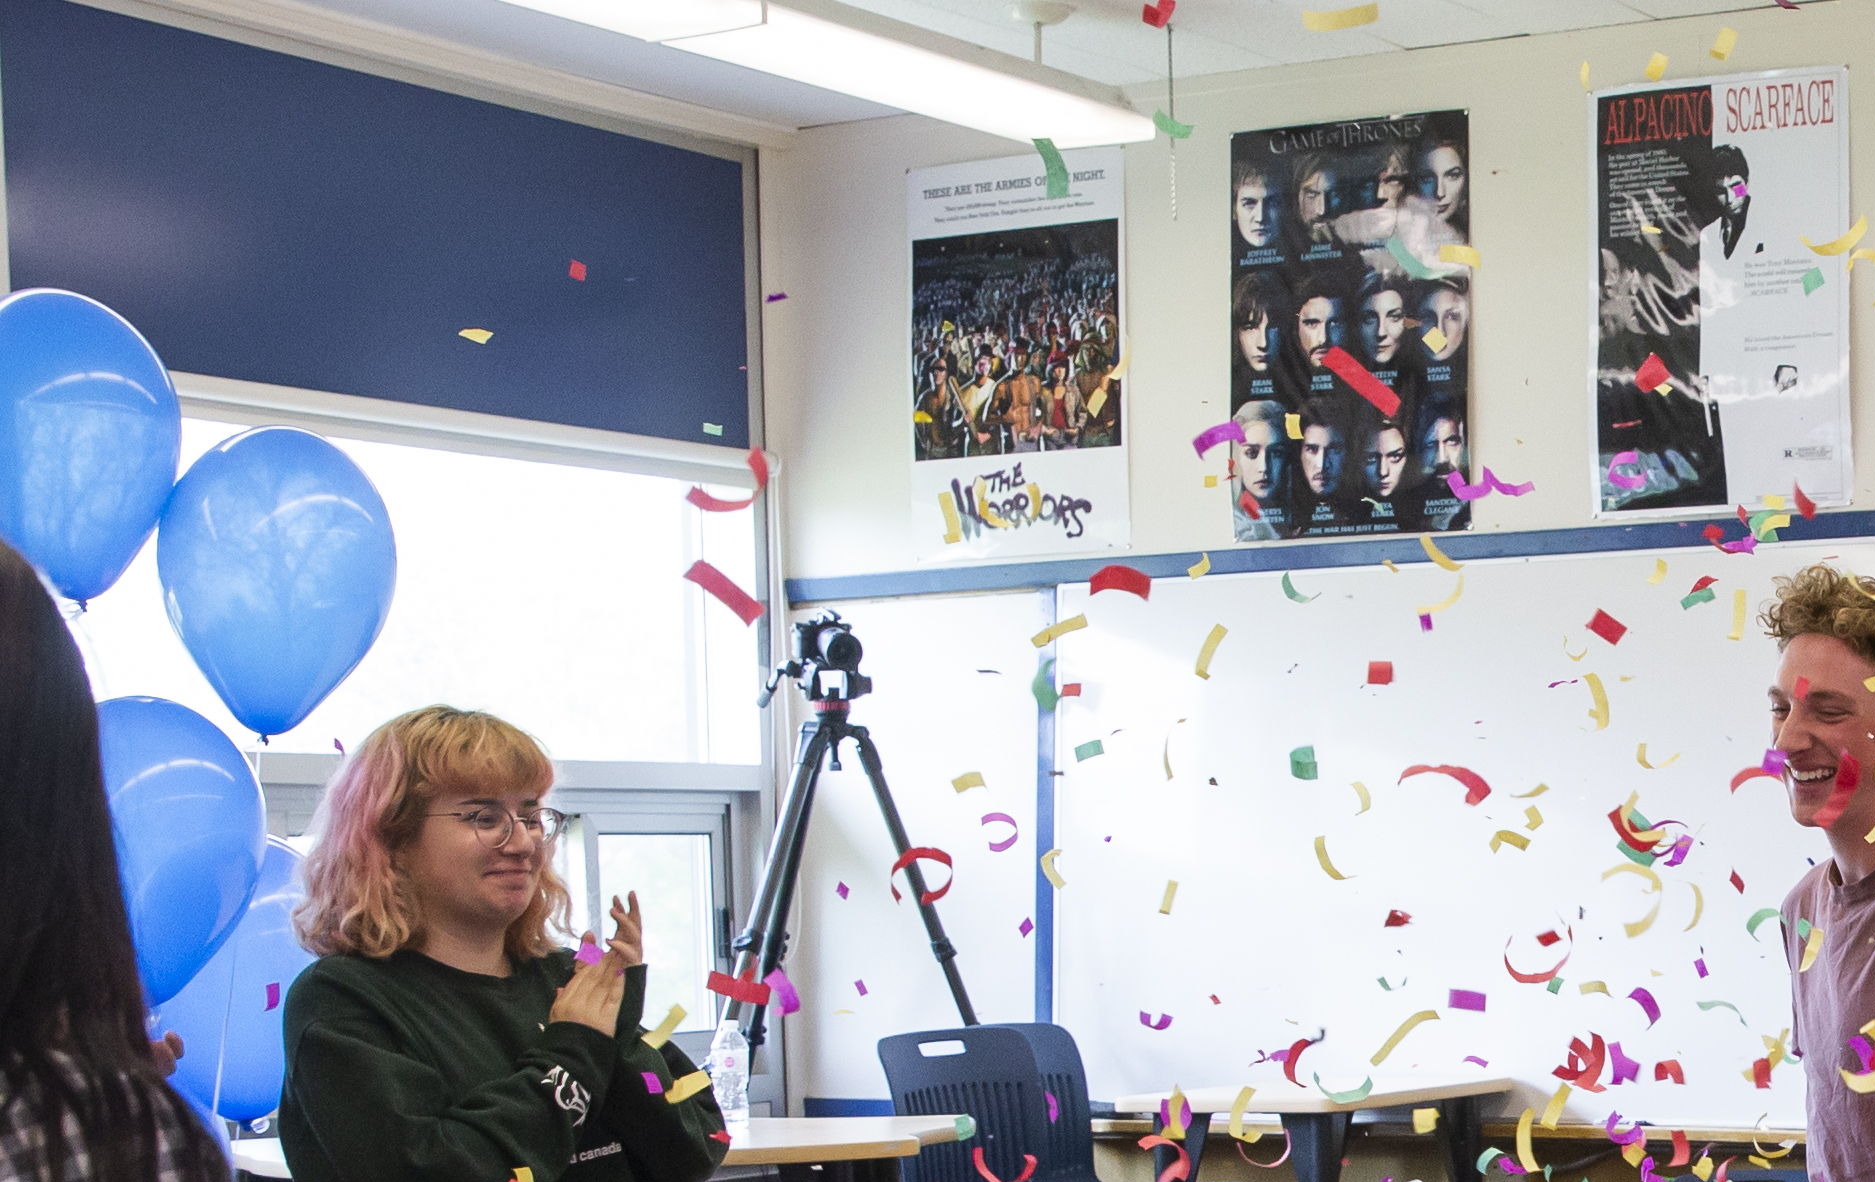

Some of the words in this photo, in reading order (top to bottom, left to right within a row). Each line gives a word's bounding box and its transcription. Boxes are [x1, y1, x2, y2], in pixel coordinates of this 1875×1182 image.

[1726, 79, 1834, 134] SCARFACE
[1269, 130, 1324, 154] GAME
[1337, 115, 1426, 148] THRONES
[922, 187, 952, 200] THESE
[954, 184, 973, 197] ARE
[974, 182, 993, 195] THE
[994, 177, 1032, 192] ARMIES
[980, 461, 1026, 494] THE
[951, 477, 1093, 543] WARRORS
[579, 1141, 622, 1162] canada
